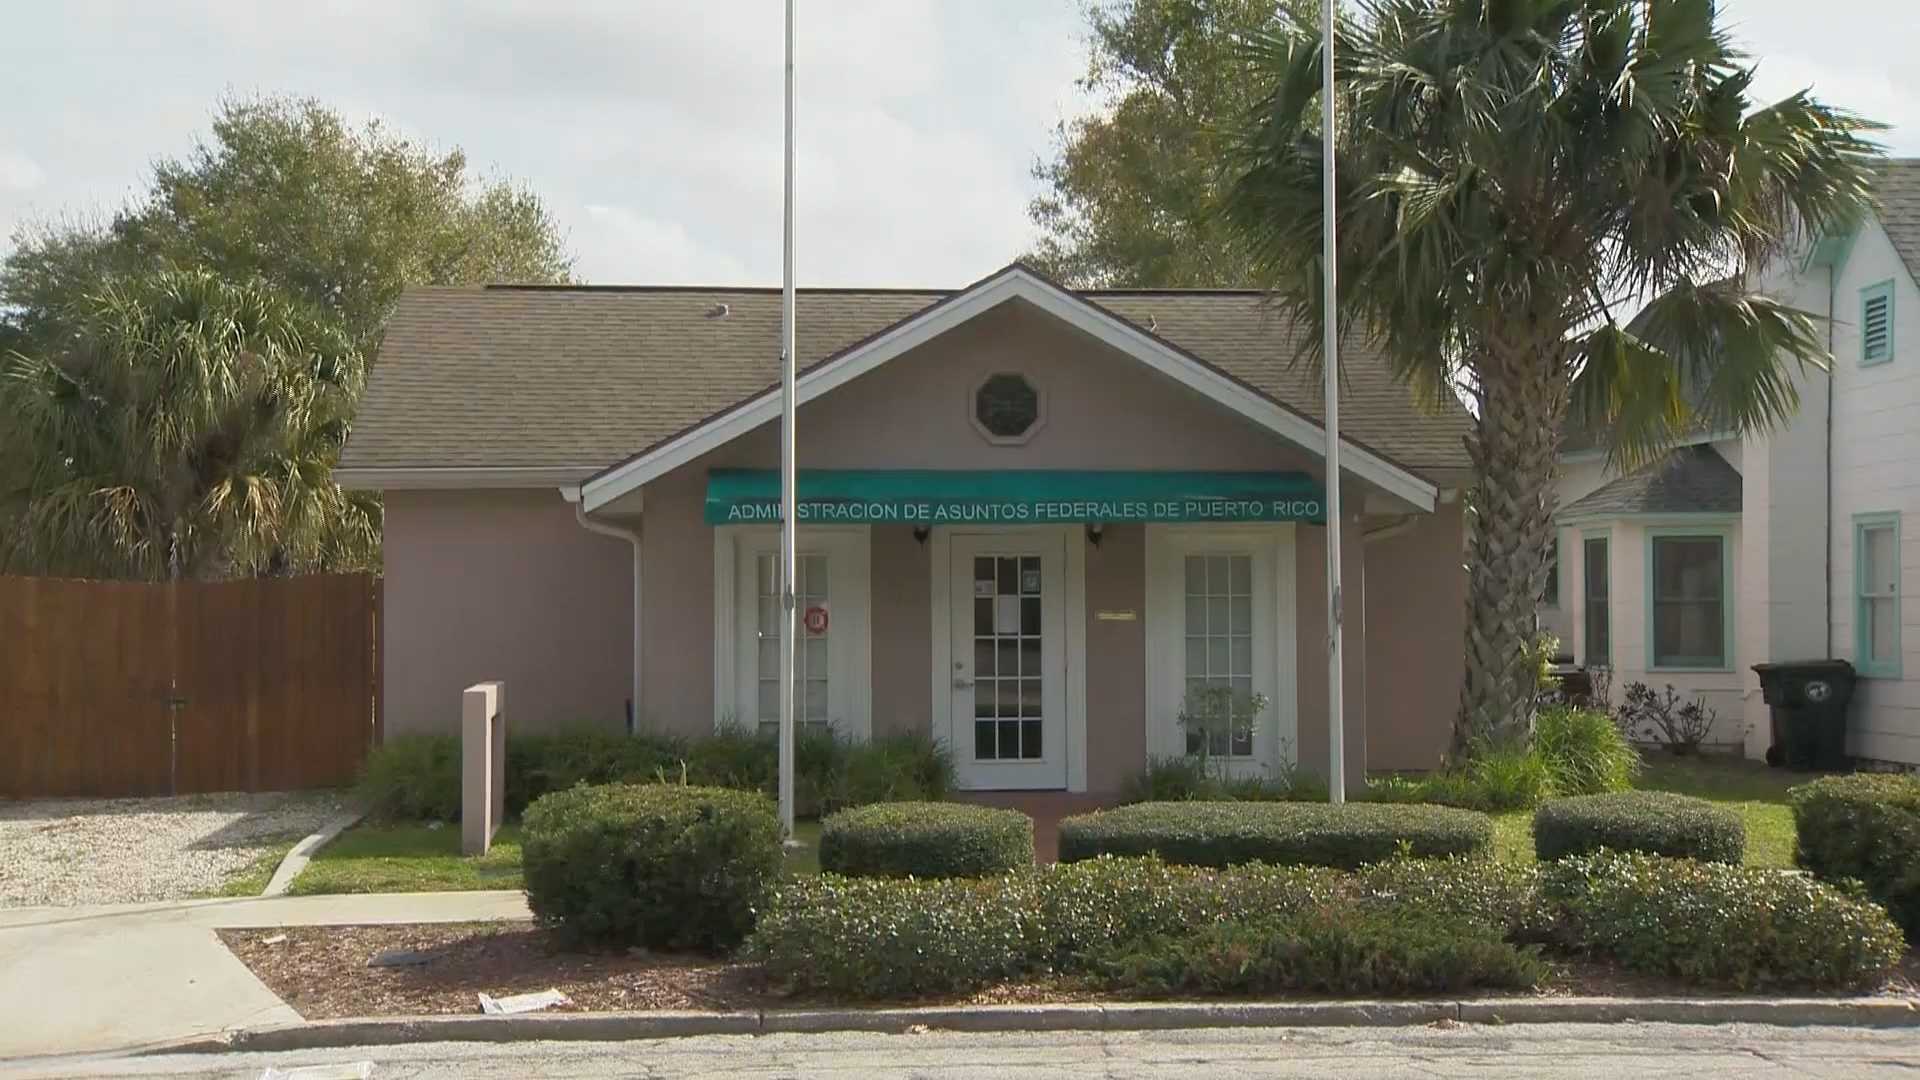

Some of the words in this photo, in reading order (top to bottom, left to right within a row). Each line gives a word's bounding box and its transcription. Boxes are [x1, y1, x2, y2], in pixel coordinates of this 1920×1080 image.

[728, 503, 898, 521] ADMISTRACION
[904, 503, 931, 519] DE
[935, 501, 1029, 519] ASUNTOS
[1034, 501, 1147, 519] FEDERALES
[1153, 501, 1179, 517] DE
[1185, 501, 1264, 517] PUERTO
[1272, 500, 1321, 516] RICO
